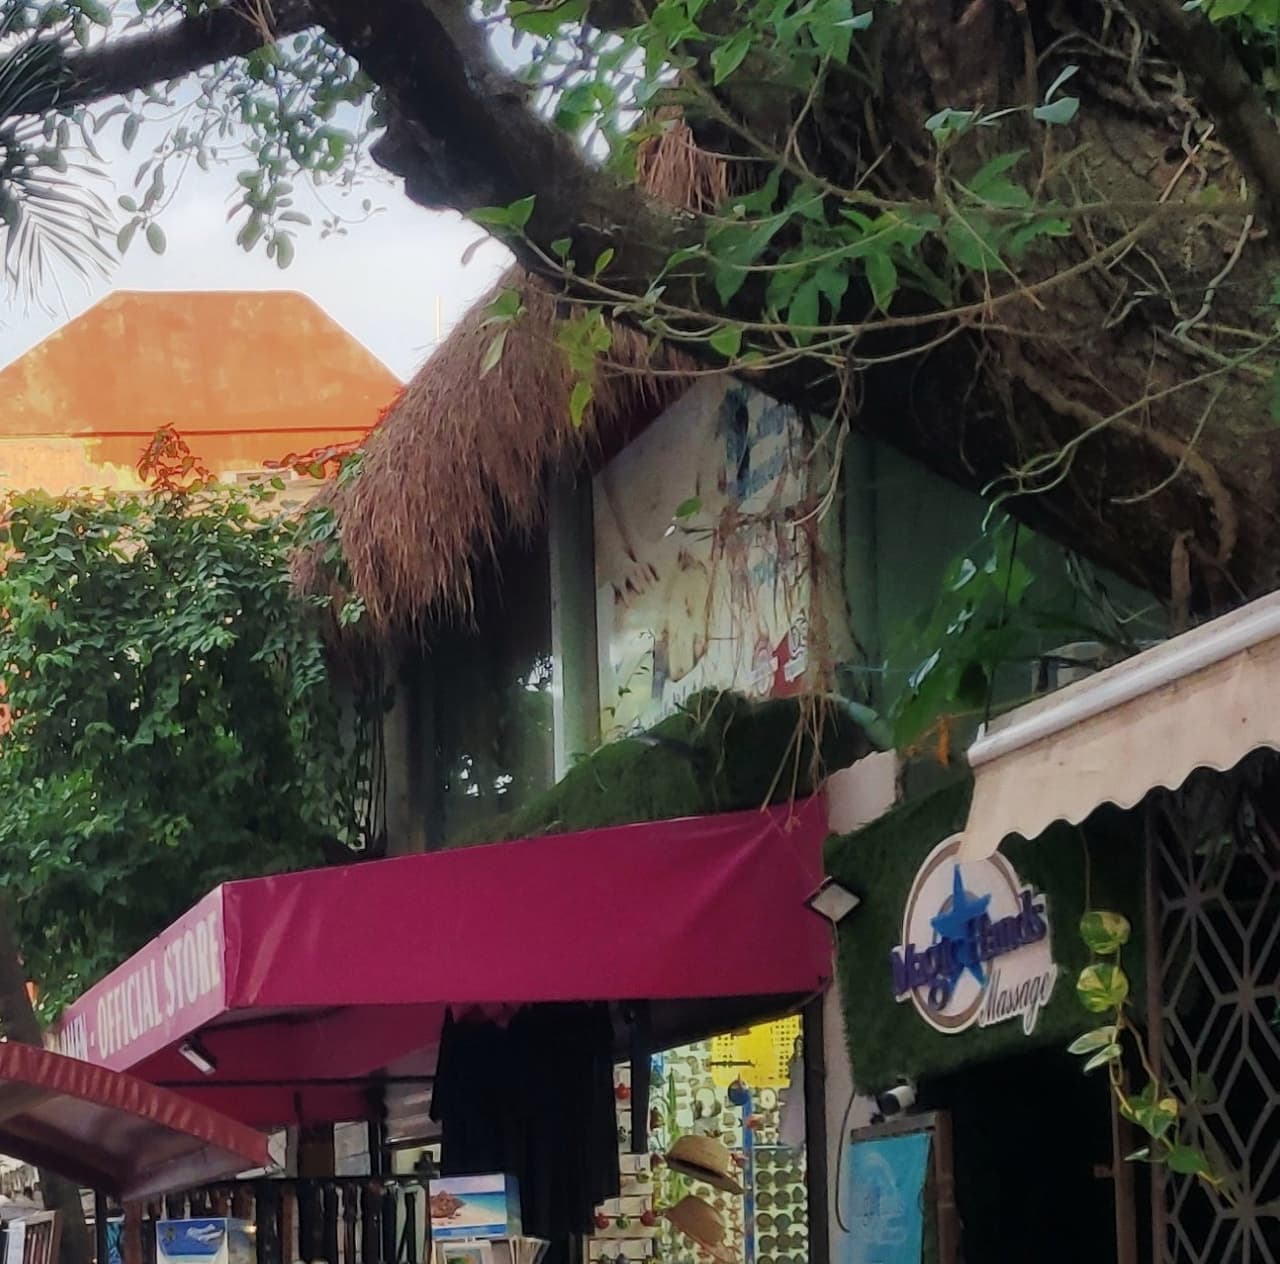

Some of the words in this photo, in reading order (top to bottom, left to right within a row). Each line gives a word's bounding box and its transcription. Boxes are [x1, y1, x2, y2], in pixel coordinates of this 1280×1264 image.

[97, 959, 163, 1060] OFFICIAL
[164, 911, 220, 1017] STORE
[979, 969, 1051, 1026] Massage
